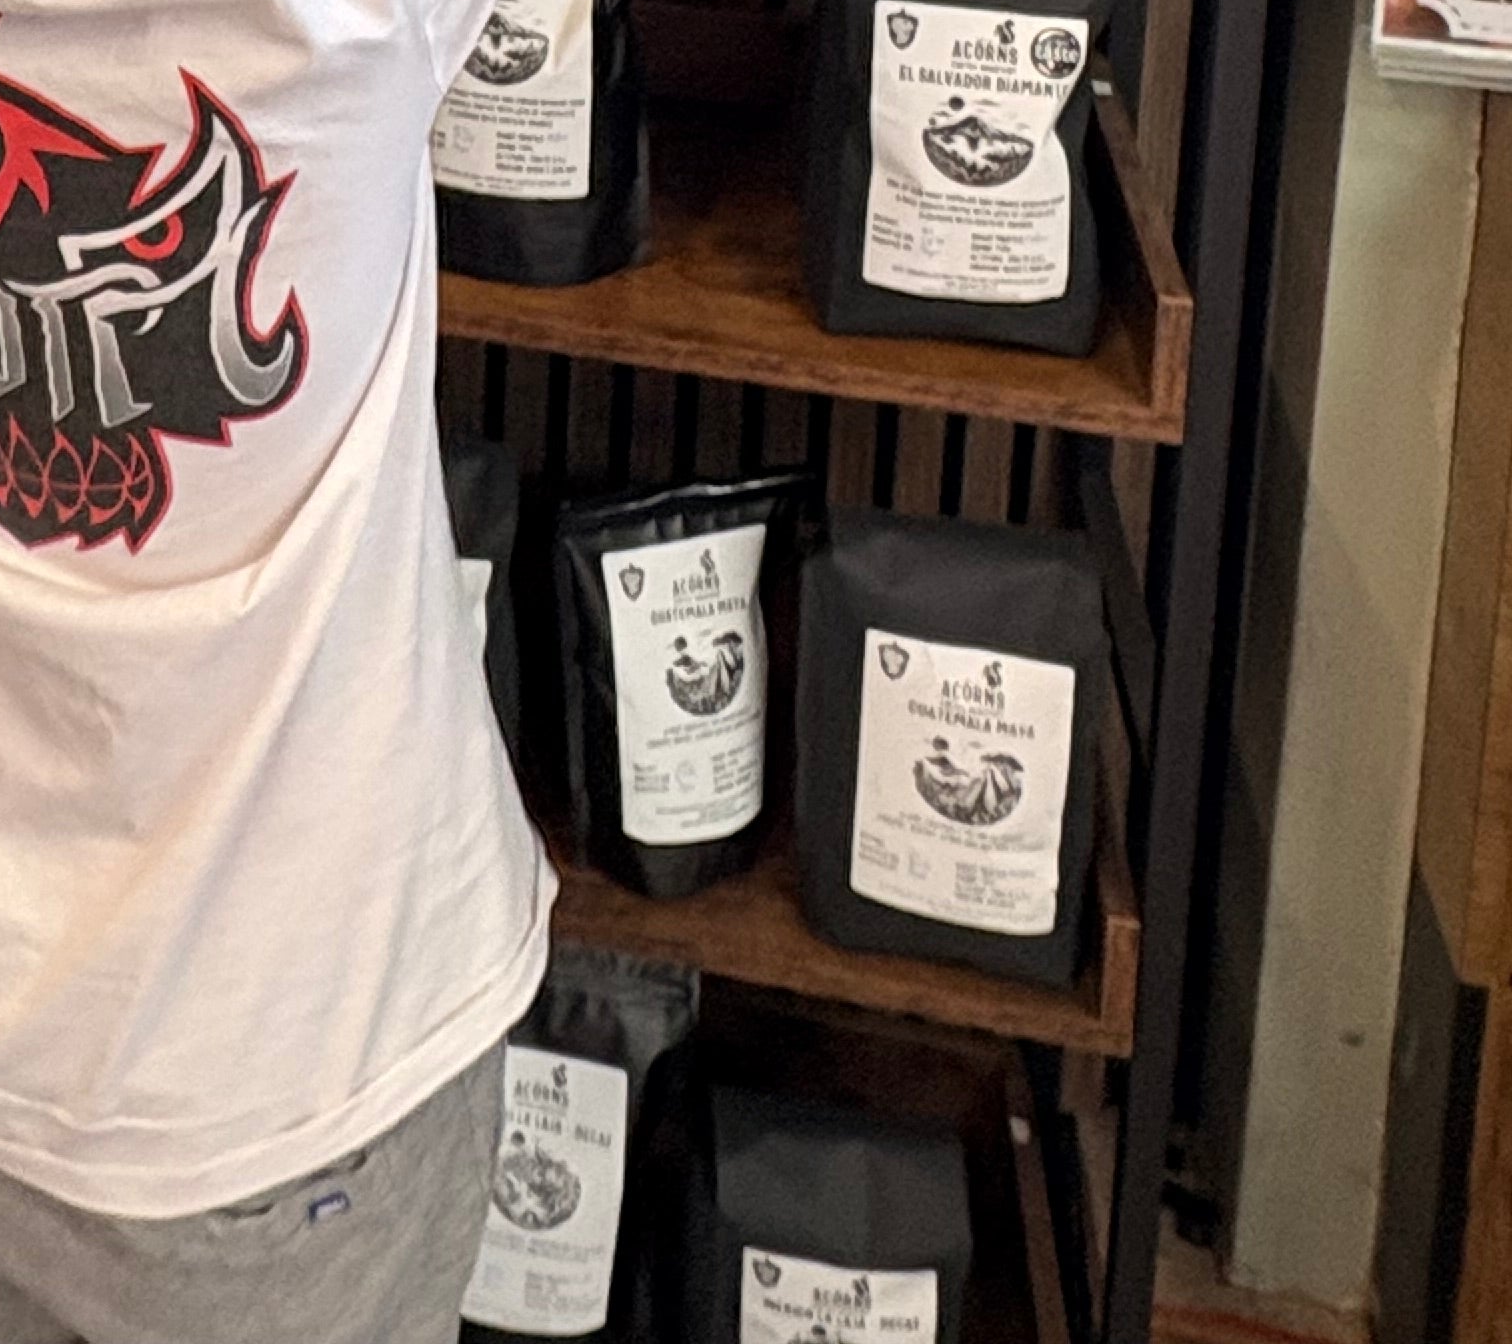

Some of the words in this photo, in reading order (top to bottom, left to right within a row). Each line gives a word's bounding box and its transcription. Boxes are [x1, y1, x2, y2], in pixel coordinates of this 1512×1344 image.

[953, 39, 1018, 65] ACORNS
[899, 64, 914, 81] EL
[918, 66, 992, 91] SALVADOR
[942, 680, 1005, 710] ACORNS
